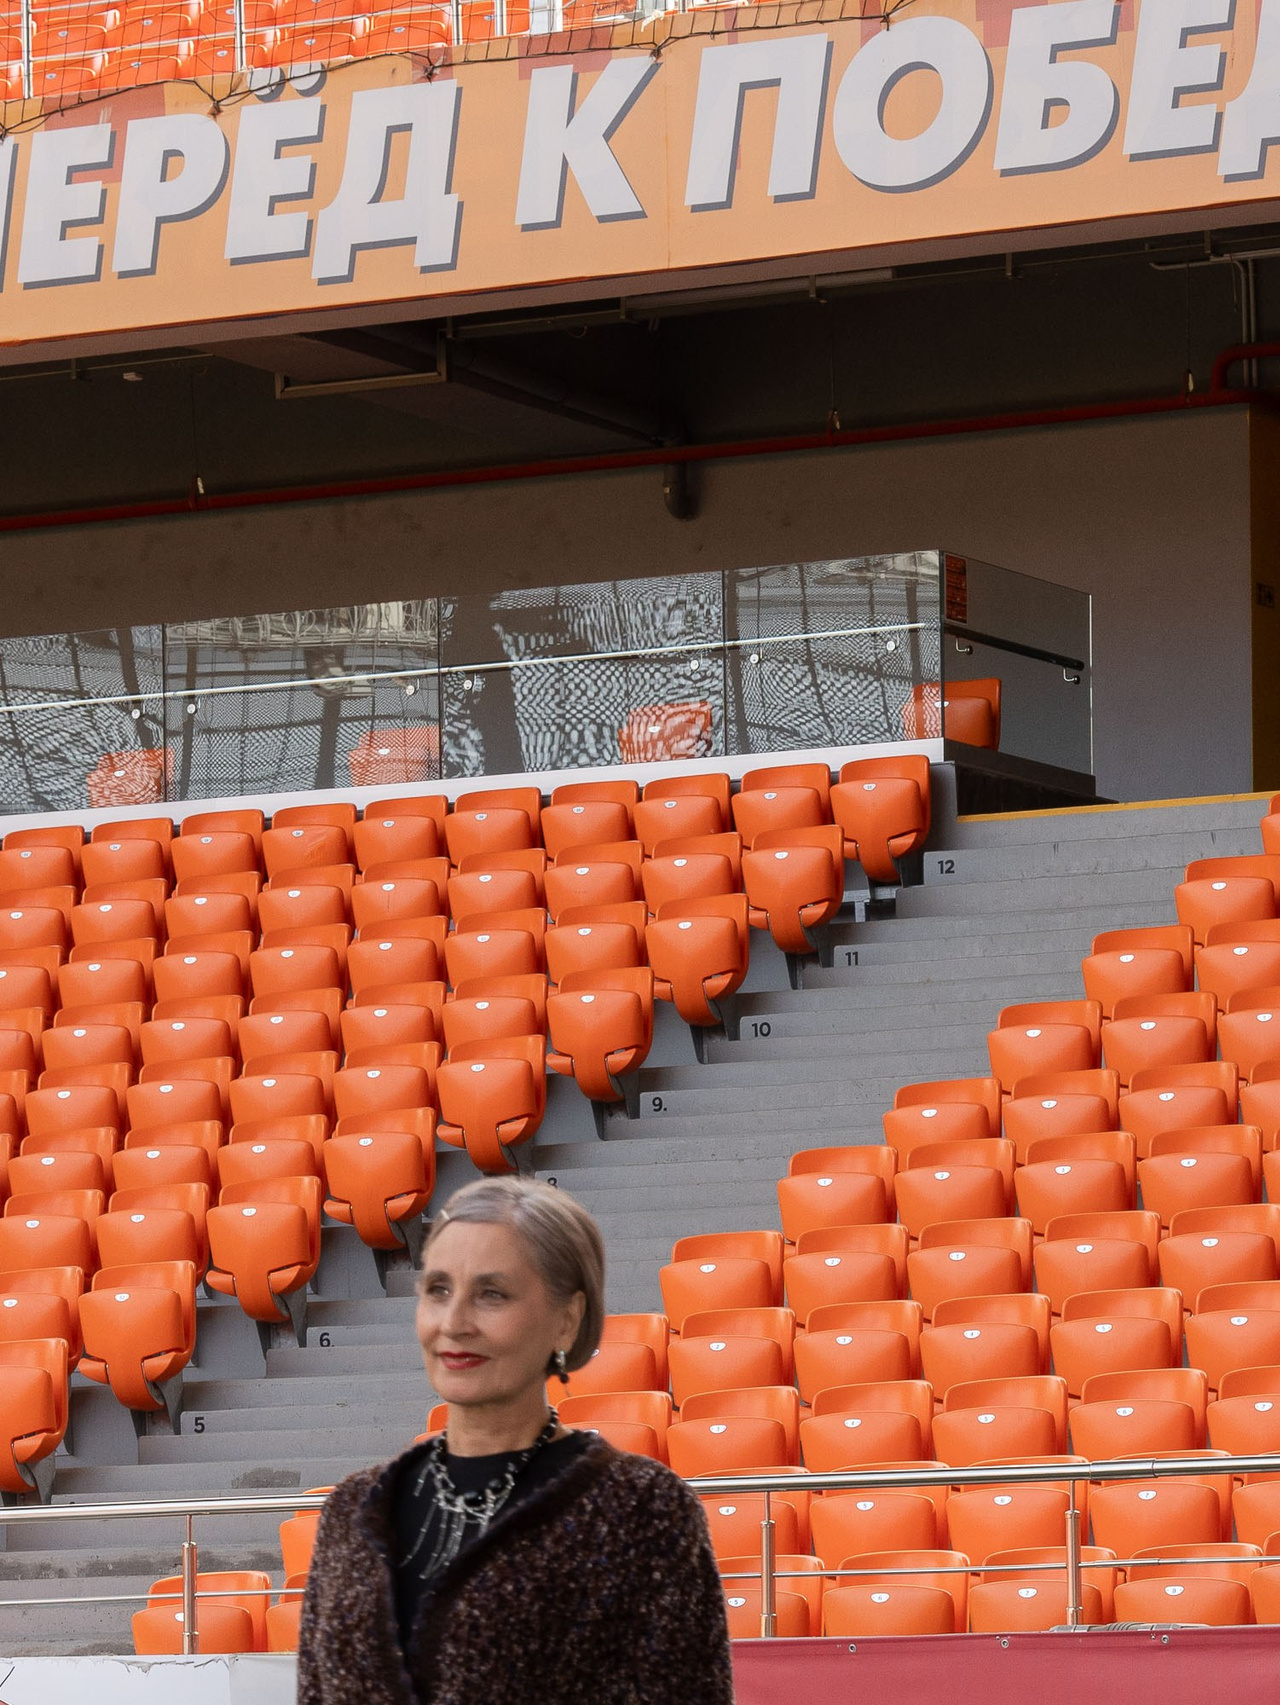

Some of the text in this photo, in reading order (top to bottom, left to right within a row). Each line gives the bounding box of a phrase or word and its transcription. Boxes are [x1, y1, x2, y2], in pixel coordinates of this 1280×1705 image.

[0, 62, 463, 291] ЕРЁД
[515, 56, 661, 233] К
[937, 860, 955, 875] 12
[845, 952, 859, 966] 11
[751, 1022, 771, 1037] 10
[652, 1097, 668, 1112] 9.
[194, 1417, 205, 1433] 5
